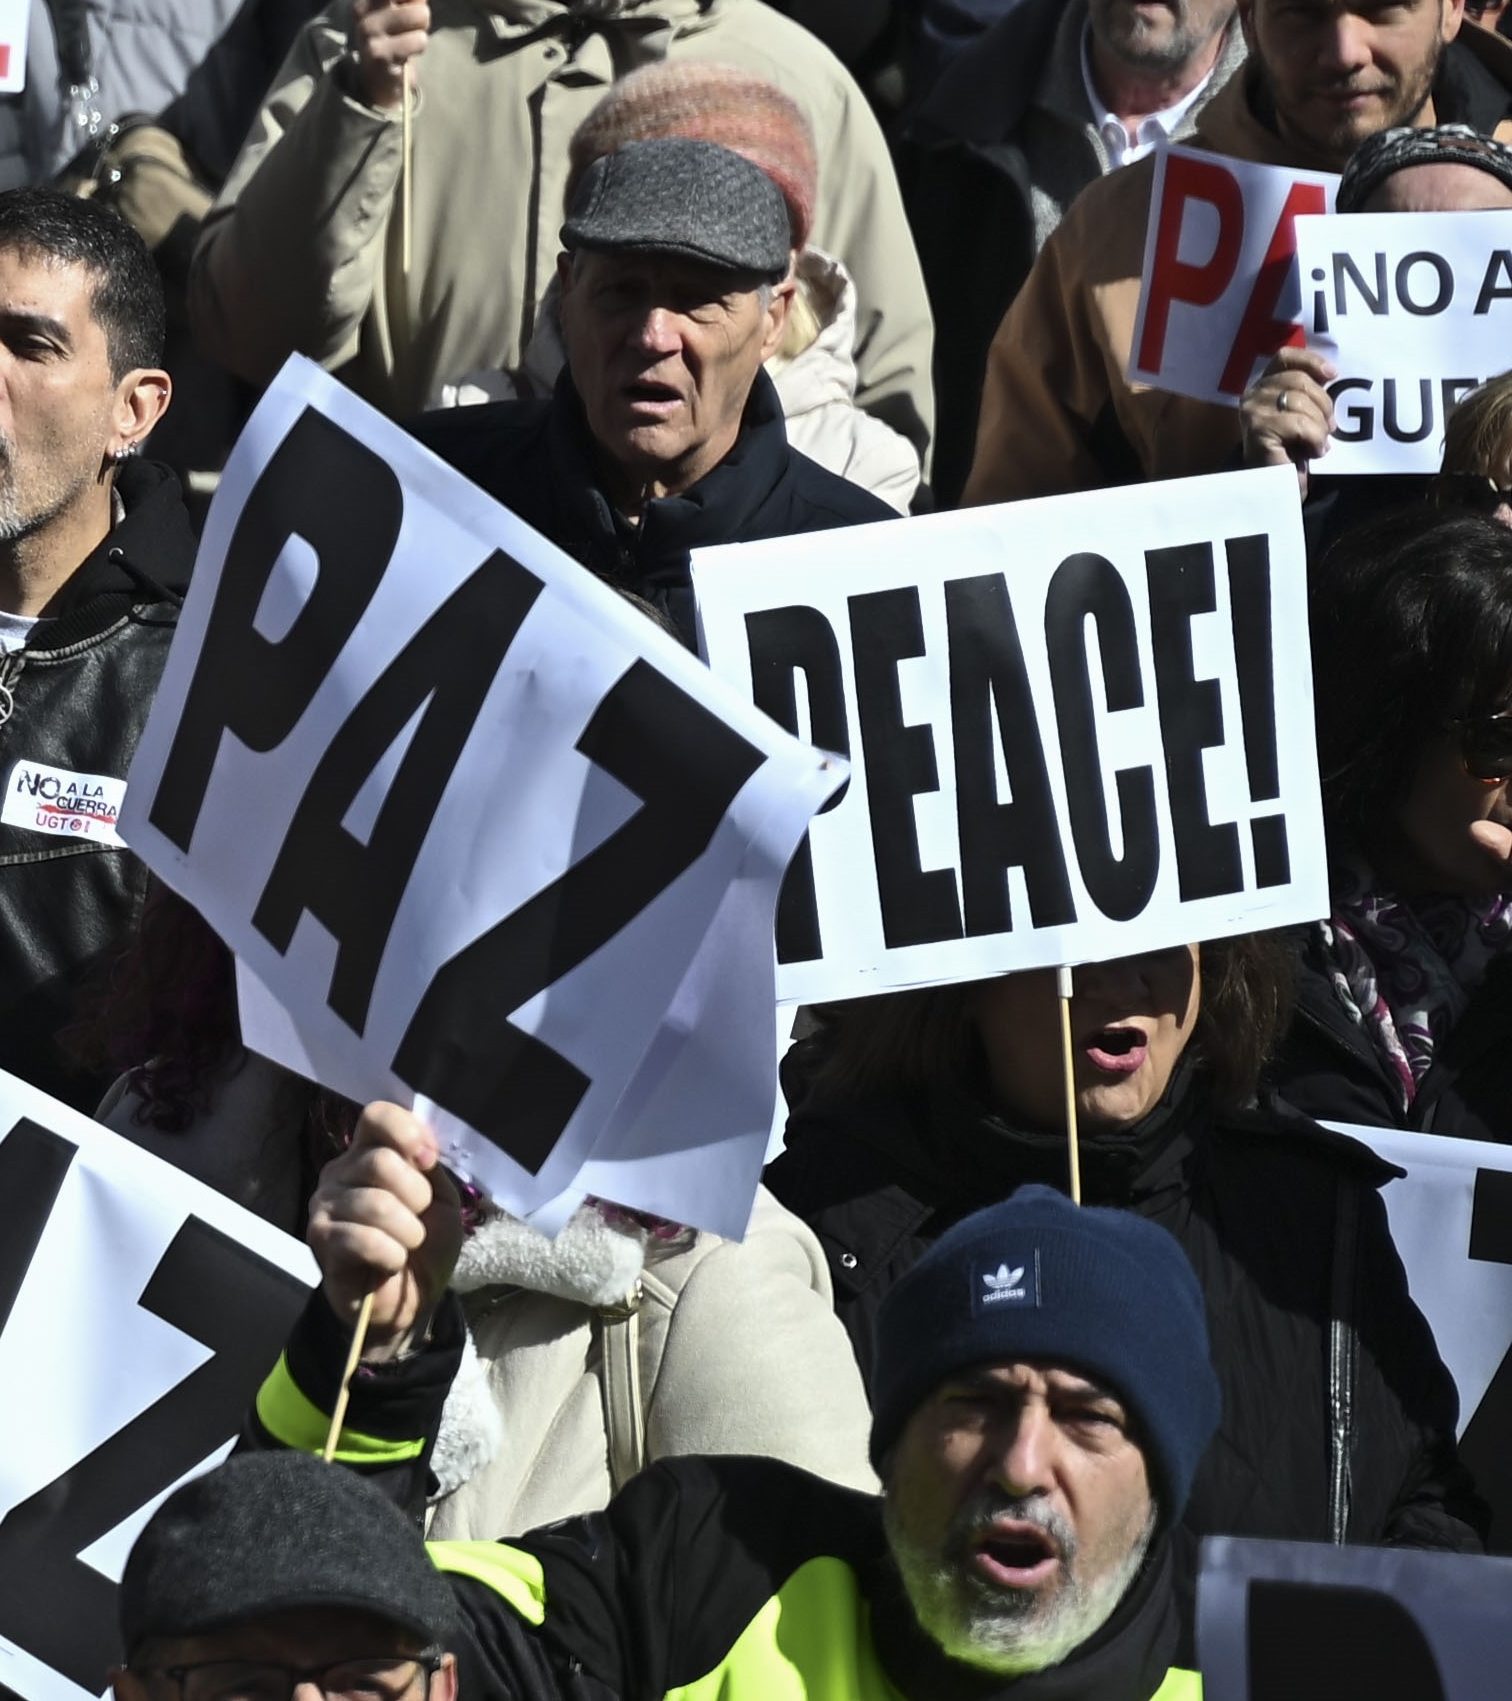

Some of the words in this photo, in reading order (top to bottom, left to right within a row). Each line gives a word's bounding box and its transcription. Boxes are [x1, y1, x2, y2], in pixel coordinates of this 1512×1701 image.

[1311, 249, 1455, 334] ¡NO
[16, 769, 61, 799] NO
[66, 782, 78, 797] A
[82, 781, 104, 798] LA
[148, 404, 769, 1177] PAZ
[745, 532, 1292, 967] PEACE!
[982, 1287, 1026, 1305] adidas
